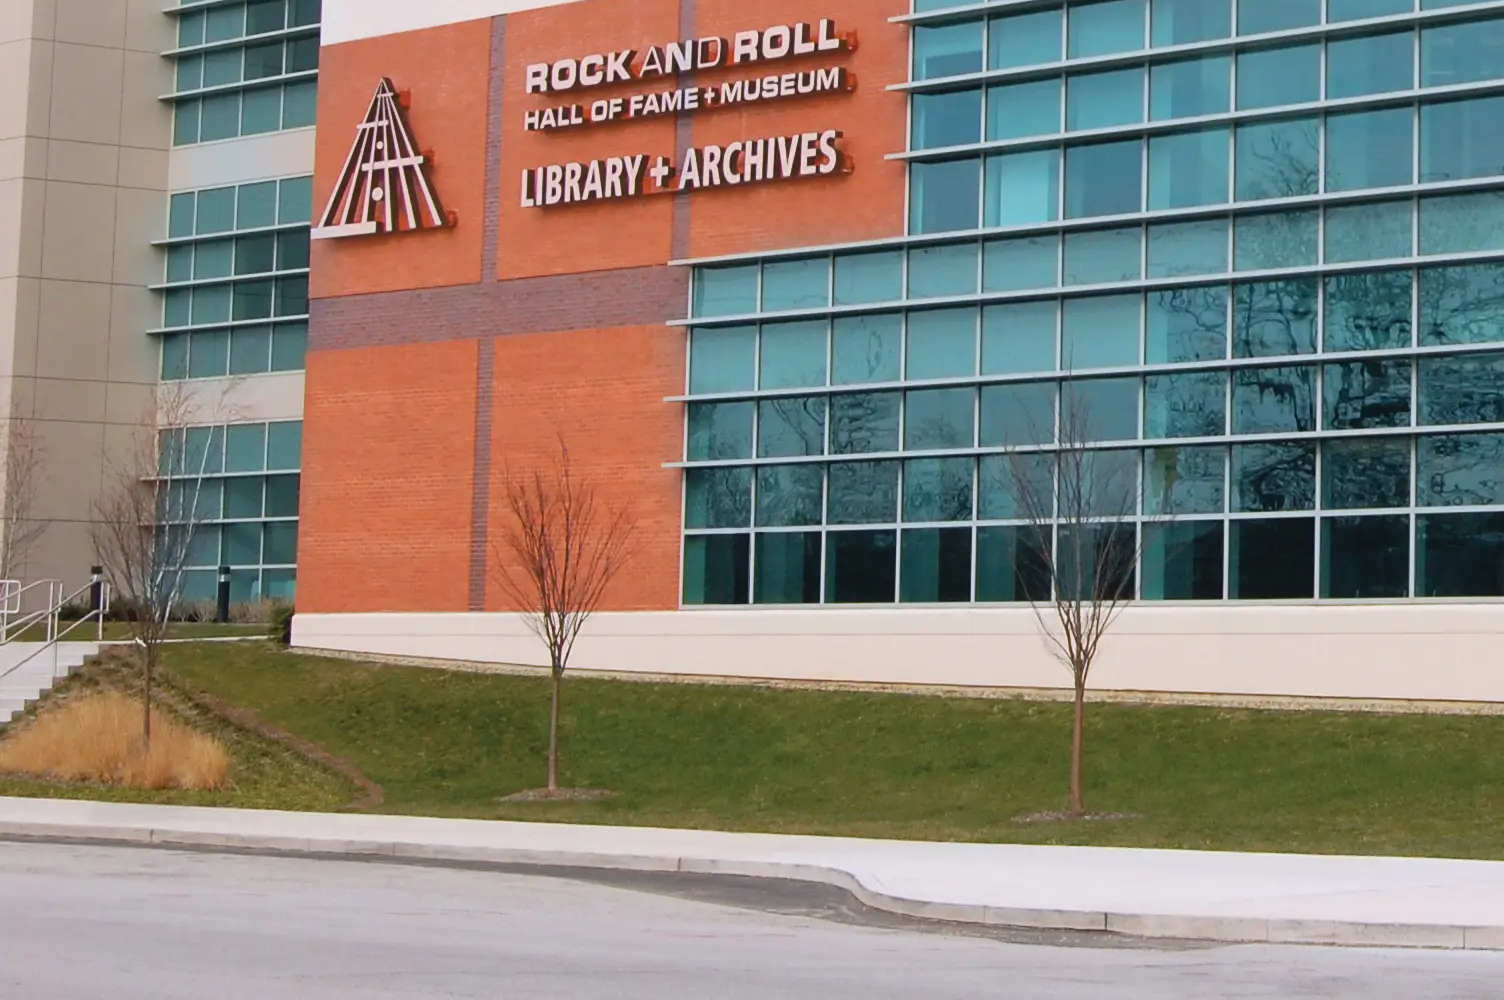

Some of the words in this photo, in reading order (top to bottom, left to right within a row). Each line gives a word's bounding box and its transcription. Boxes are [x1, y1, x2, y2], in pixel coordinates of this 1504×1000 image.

[525, 50, 636, 94] ROCK
[639, 36, 726, 77] AND
[733, 18, 840, 63] ROLL
[524, 104, 583, 131] HALL
[590, 98, 623, 122] OF
[629, 87, 699, 117] FAME
[720, 66, 840, 103] MUSEUM
[521, 153, 644, 208] LIBRARY
[678, 129, 838, 189] ARCHIVES
